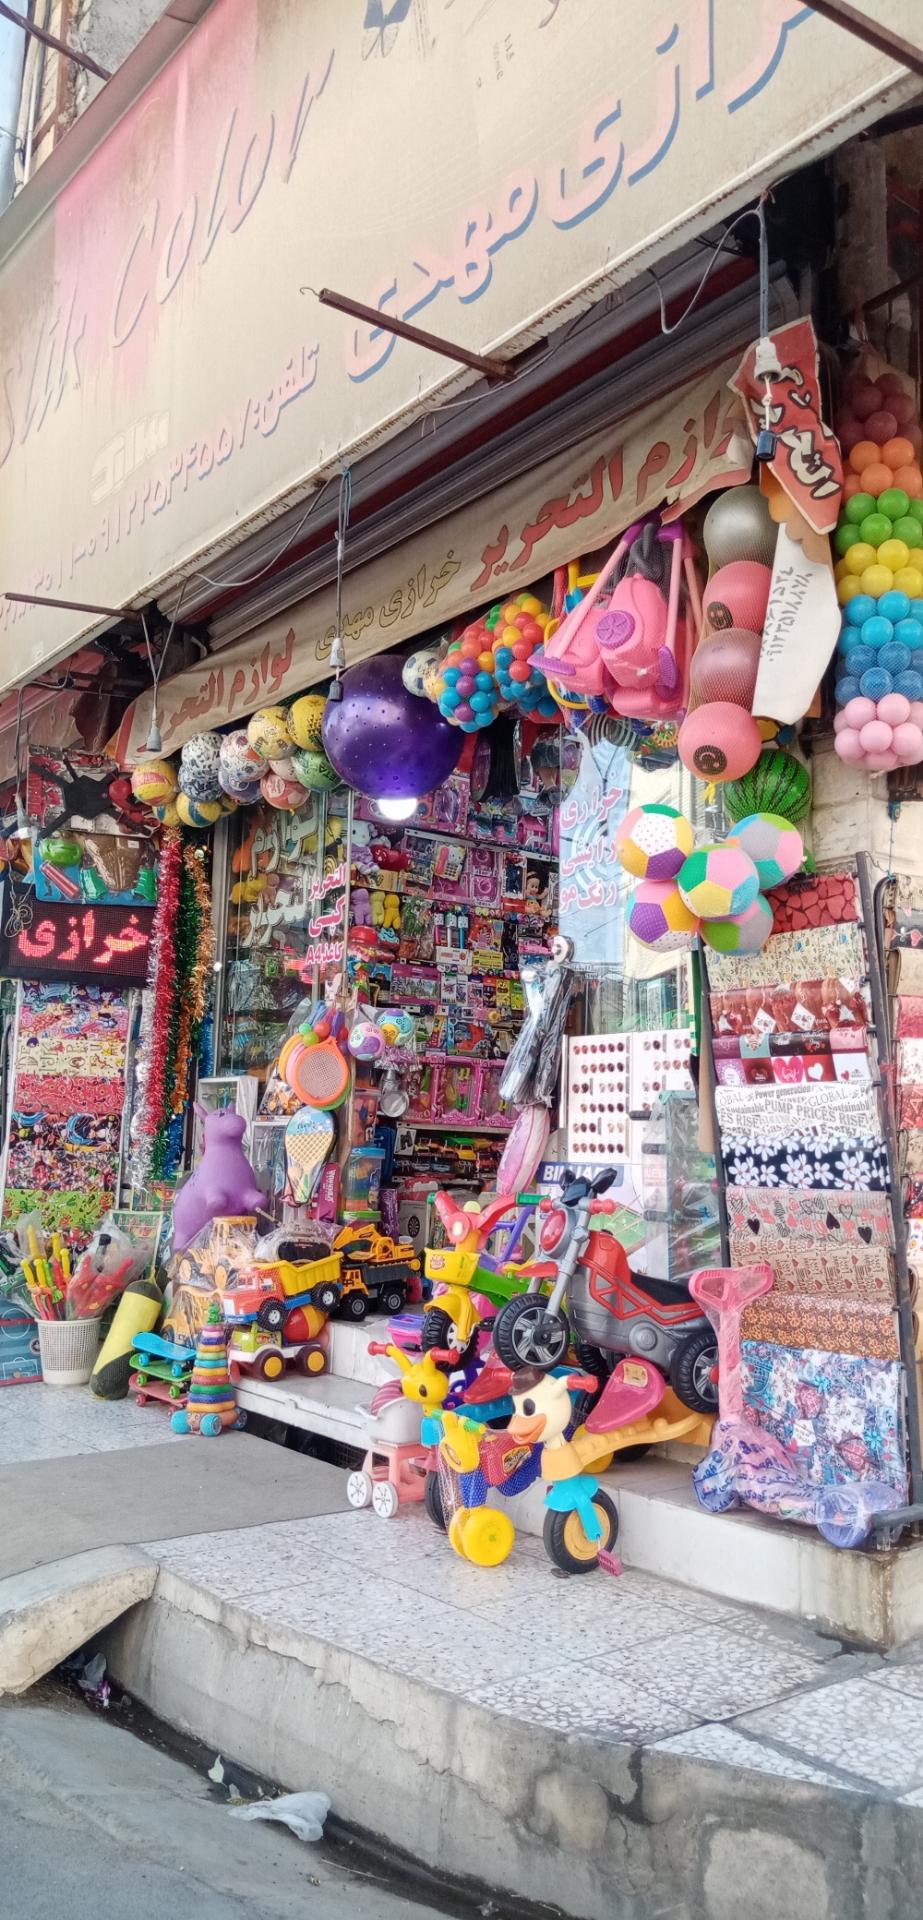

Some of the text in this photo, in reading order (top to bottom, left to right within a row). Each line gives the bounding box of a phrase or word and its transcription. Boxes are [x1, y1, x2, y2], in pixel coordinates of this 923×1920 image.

[108, 46, 336, 348] Color
[343, 0, 815, 383] رازی مهدی
[470, 453, 624, 593] التحریر
[379, 547, 462, 625] خرازی
[313, 600, 376, 662] مهدی
[230, 626, 297, 706] لوازم
[560, 786, 623, 830] خرازی
[18, 909, 148, 964] خرازی
[307, 895, 346, 938] کپی
[765, 1099, 793, 1114] PUMP
[796, 1105, 836, 1122] PRICES
[808, 1088, 848, 1107] GLOBAL
